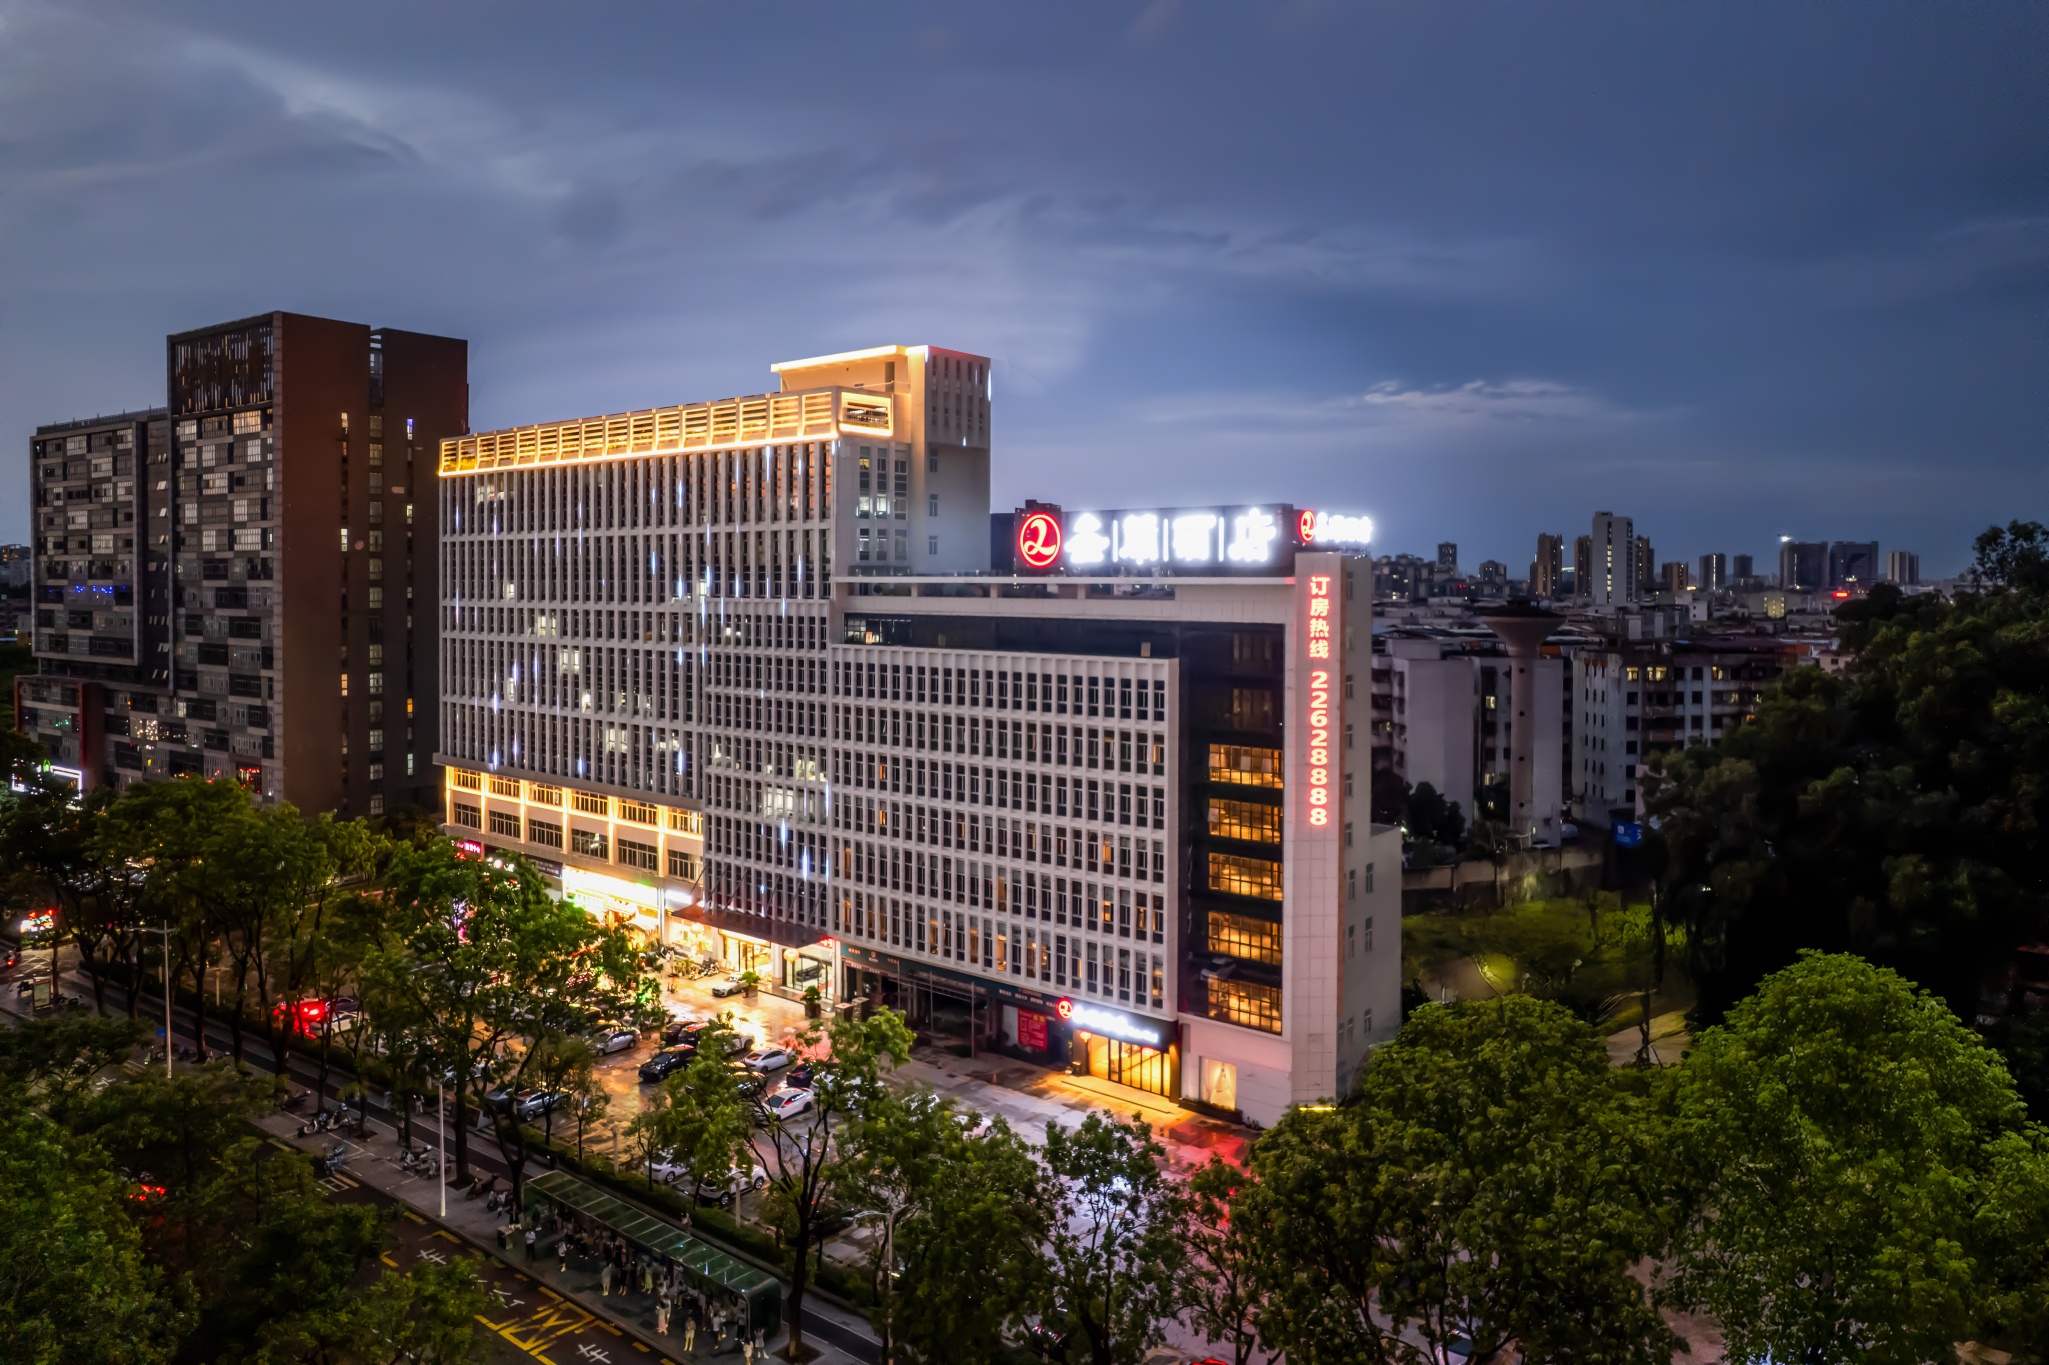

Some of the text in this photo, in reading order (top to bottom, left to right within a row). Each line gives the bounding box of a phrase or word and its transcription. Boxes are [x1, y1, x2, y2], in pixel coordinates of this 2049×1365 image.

[1308, 575, 1331, 826] 订房热线 22628888
